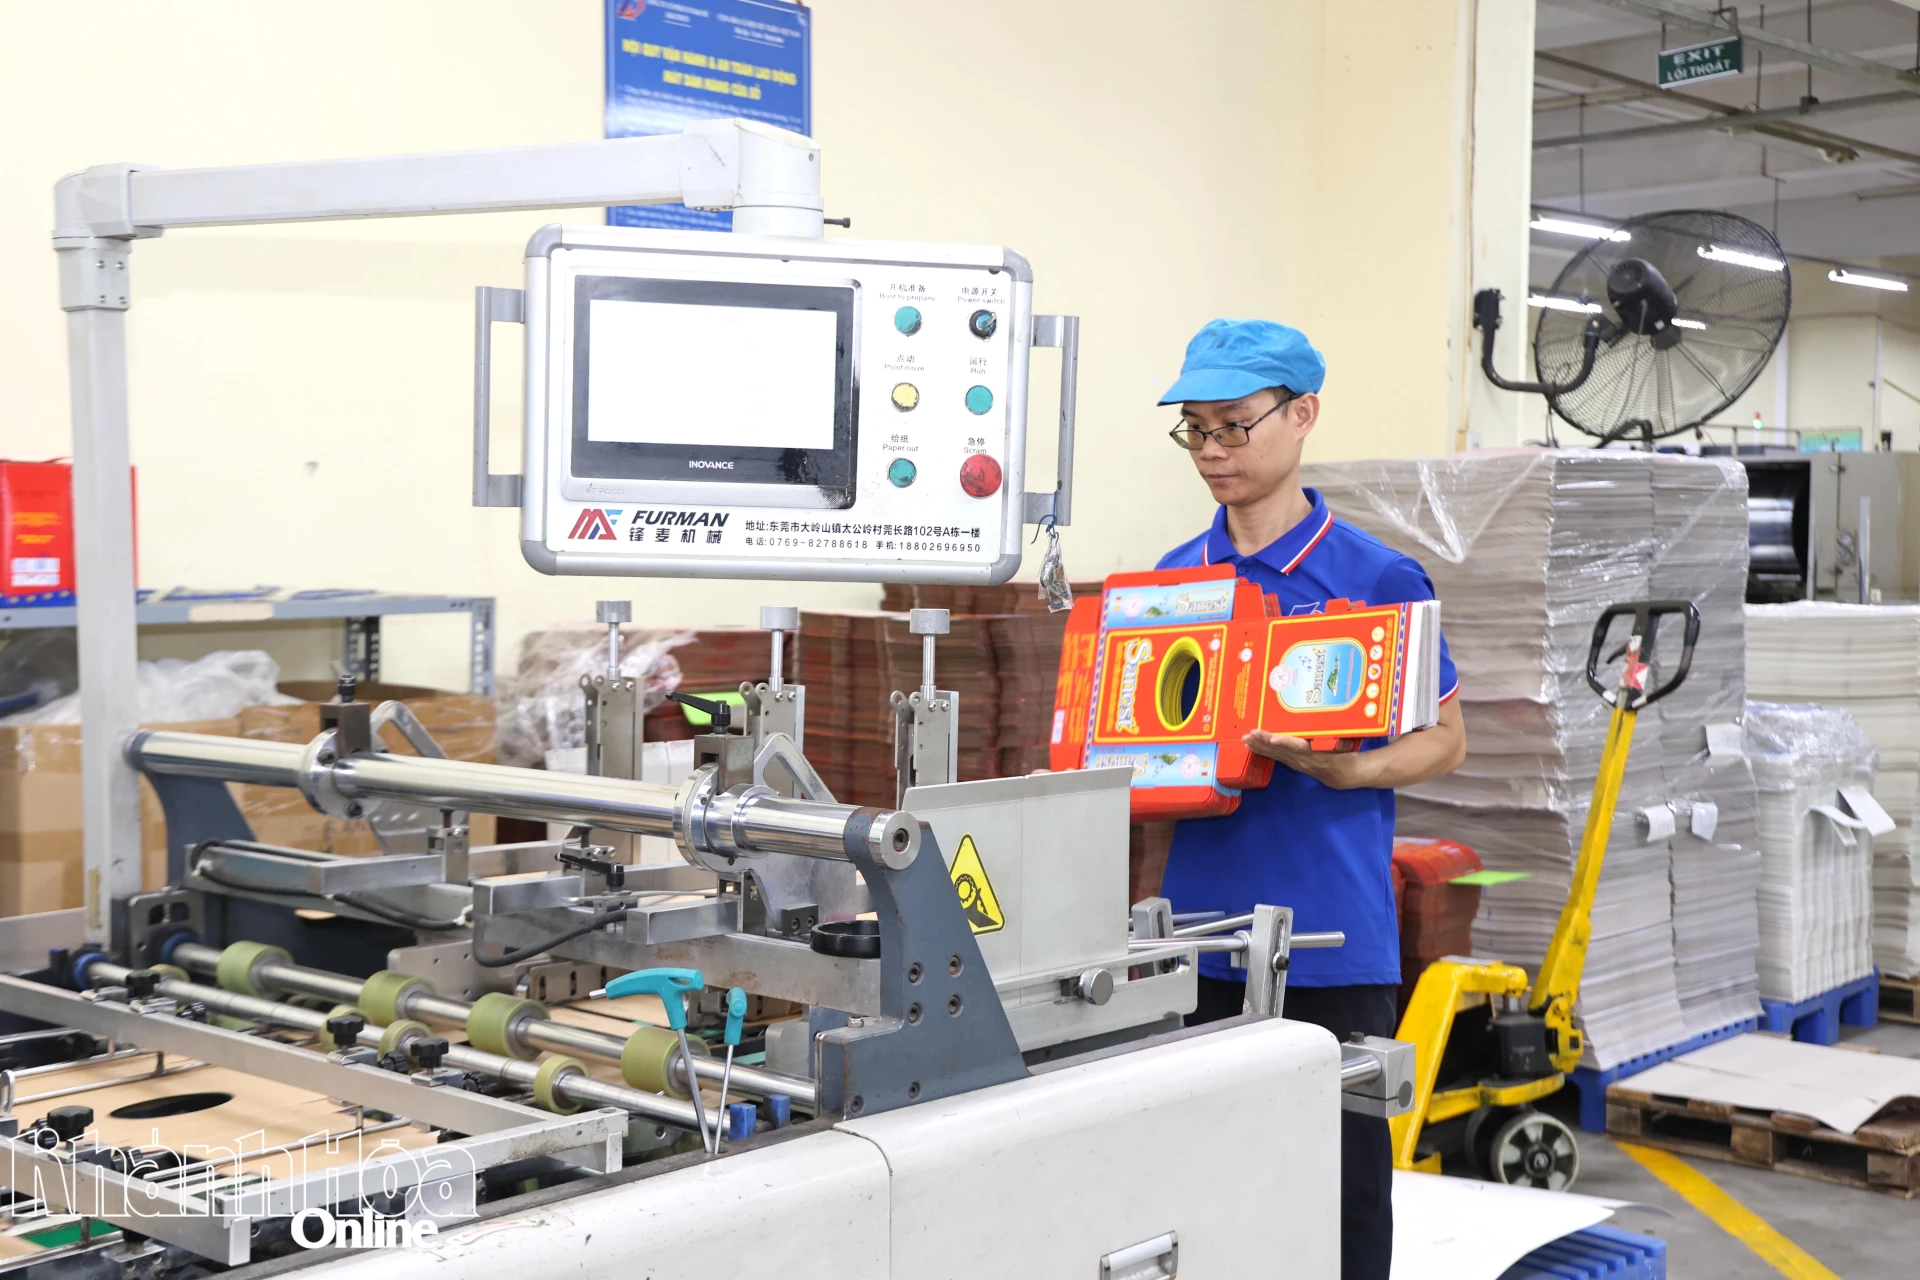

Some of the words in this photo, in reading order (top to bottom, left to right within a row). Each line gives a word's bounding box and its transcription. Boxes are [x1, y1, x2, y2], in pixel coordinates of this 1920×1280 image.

[1673, 45, 1724, 66] EXIT
[1689, 58, 1732, 78] THOÁT
[890, 283, 926, 293] 开机准备
[961, 286, 998, 297] 电源开关
[957, 295, 980, 303] Power
[896, 354, 915, 363] 点动
[969, 357, 988, 367] 运行
[884, 363, 904, 371] Point
[971, 367, 986, 375] Run
[890, 434, 909, 444] 给纸
[967, 437, 986, 447] 急停
[882, 444, 905, 453] Paper
[963, 447, 987, 455] Scram
[689, 460, 734, 470] INOVANCE
[631, 510, 730, 527] FURMAN
[629, 527, 723, 544] 锋麦机械
[1174, 591, 1230, 617] Sanest
[1305, 647, 1327, 704] Sanest
[1115, 637, 1154, 734] Sanest
